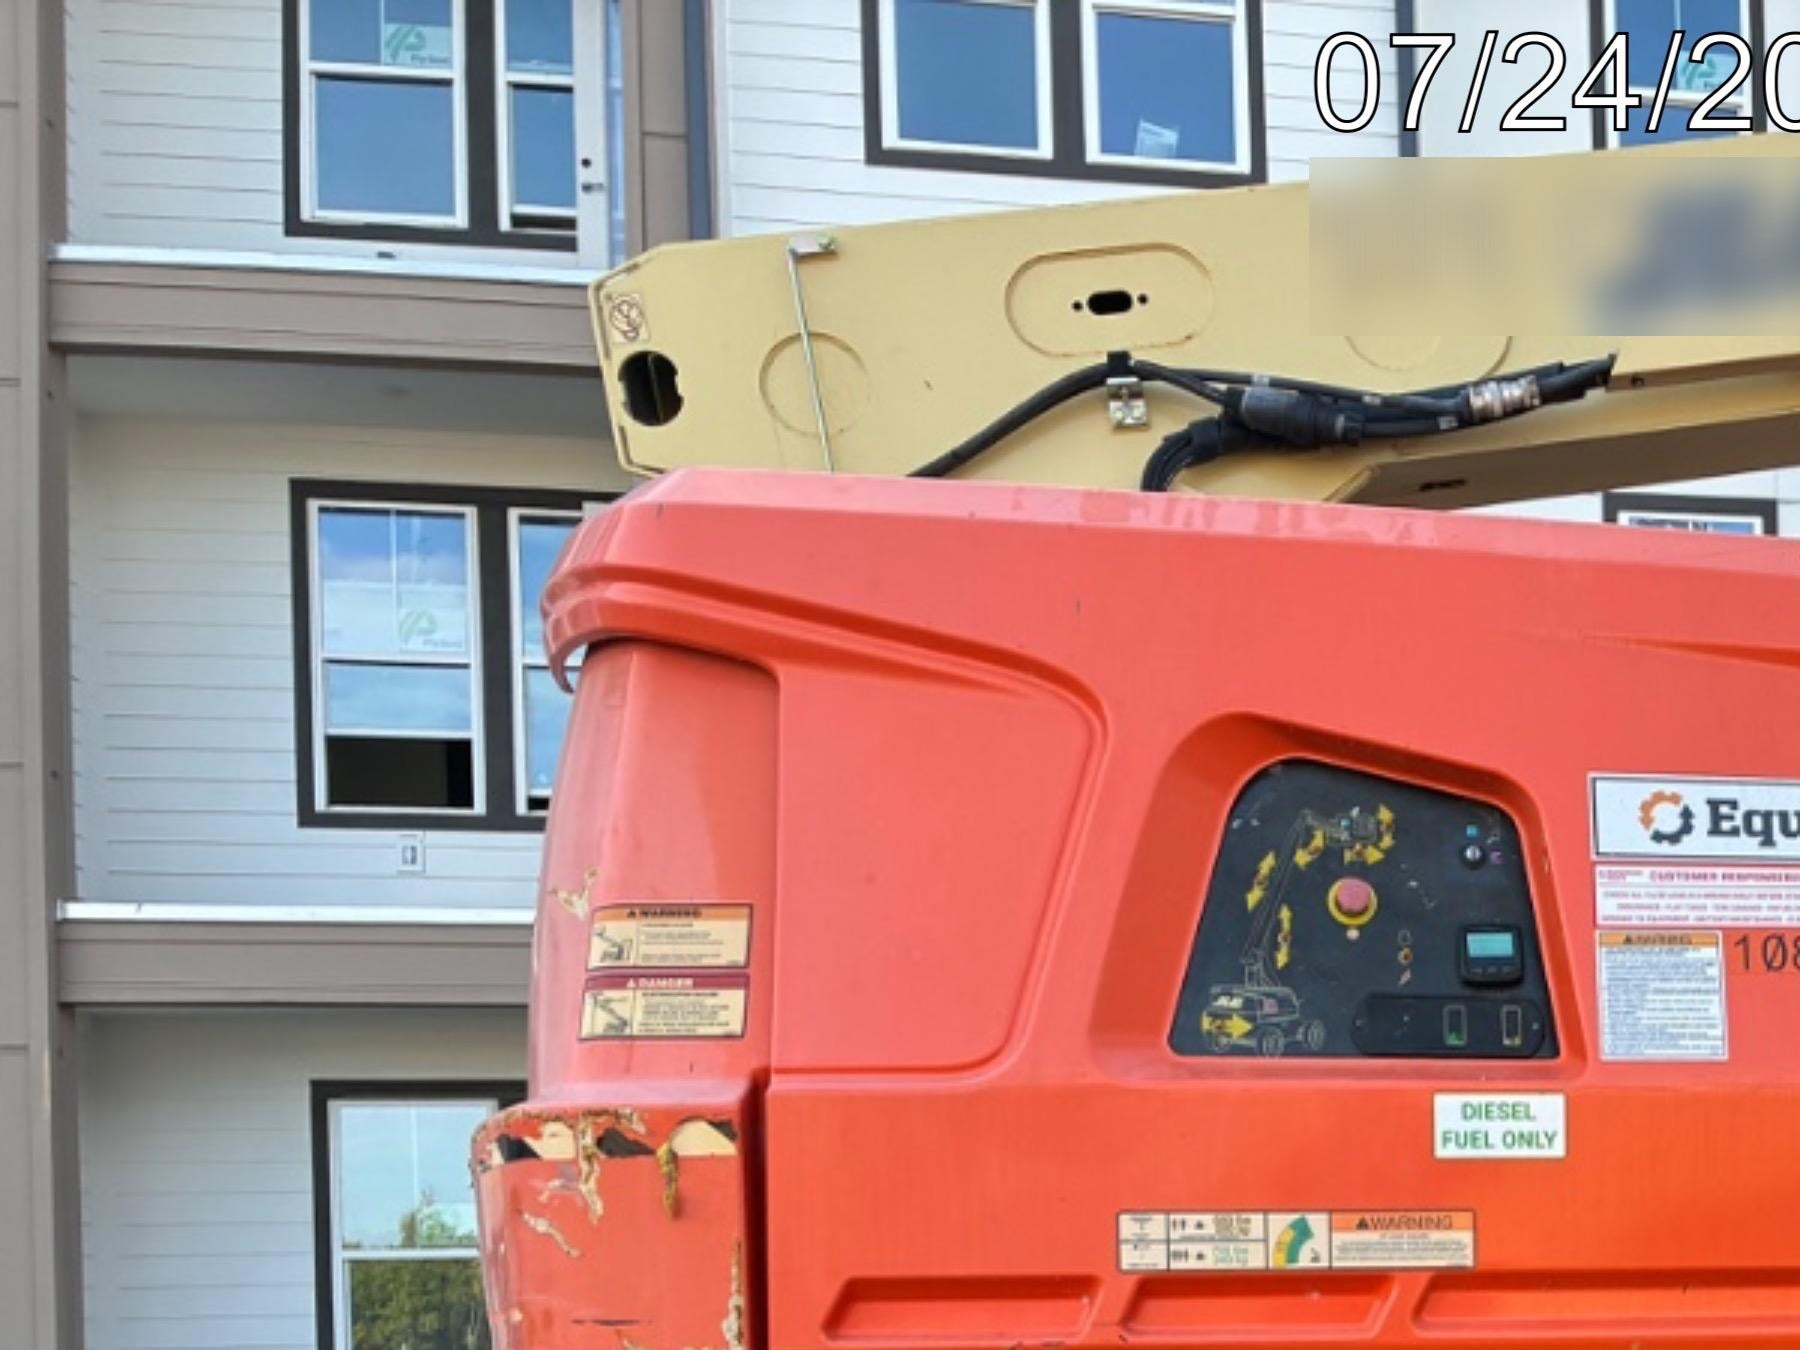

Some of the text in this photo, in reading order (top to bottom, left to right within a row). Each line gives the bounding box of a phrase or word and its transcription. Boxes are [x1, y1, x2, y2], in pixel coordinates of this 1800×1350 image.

[1460, 1101, 1537, 1121] DIESEL
[1441, 1130, 1558, 1149] FUEL ONLY
[1370, 1215, 1453, 1231] WARNING
